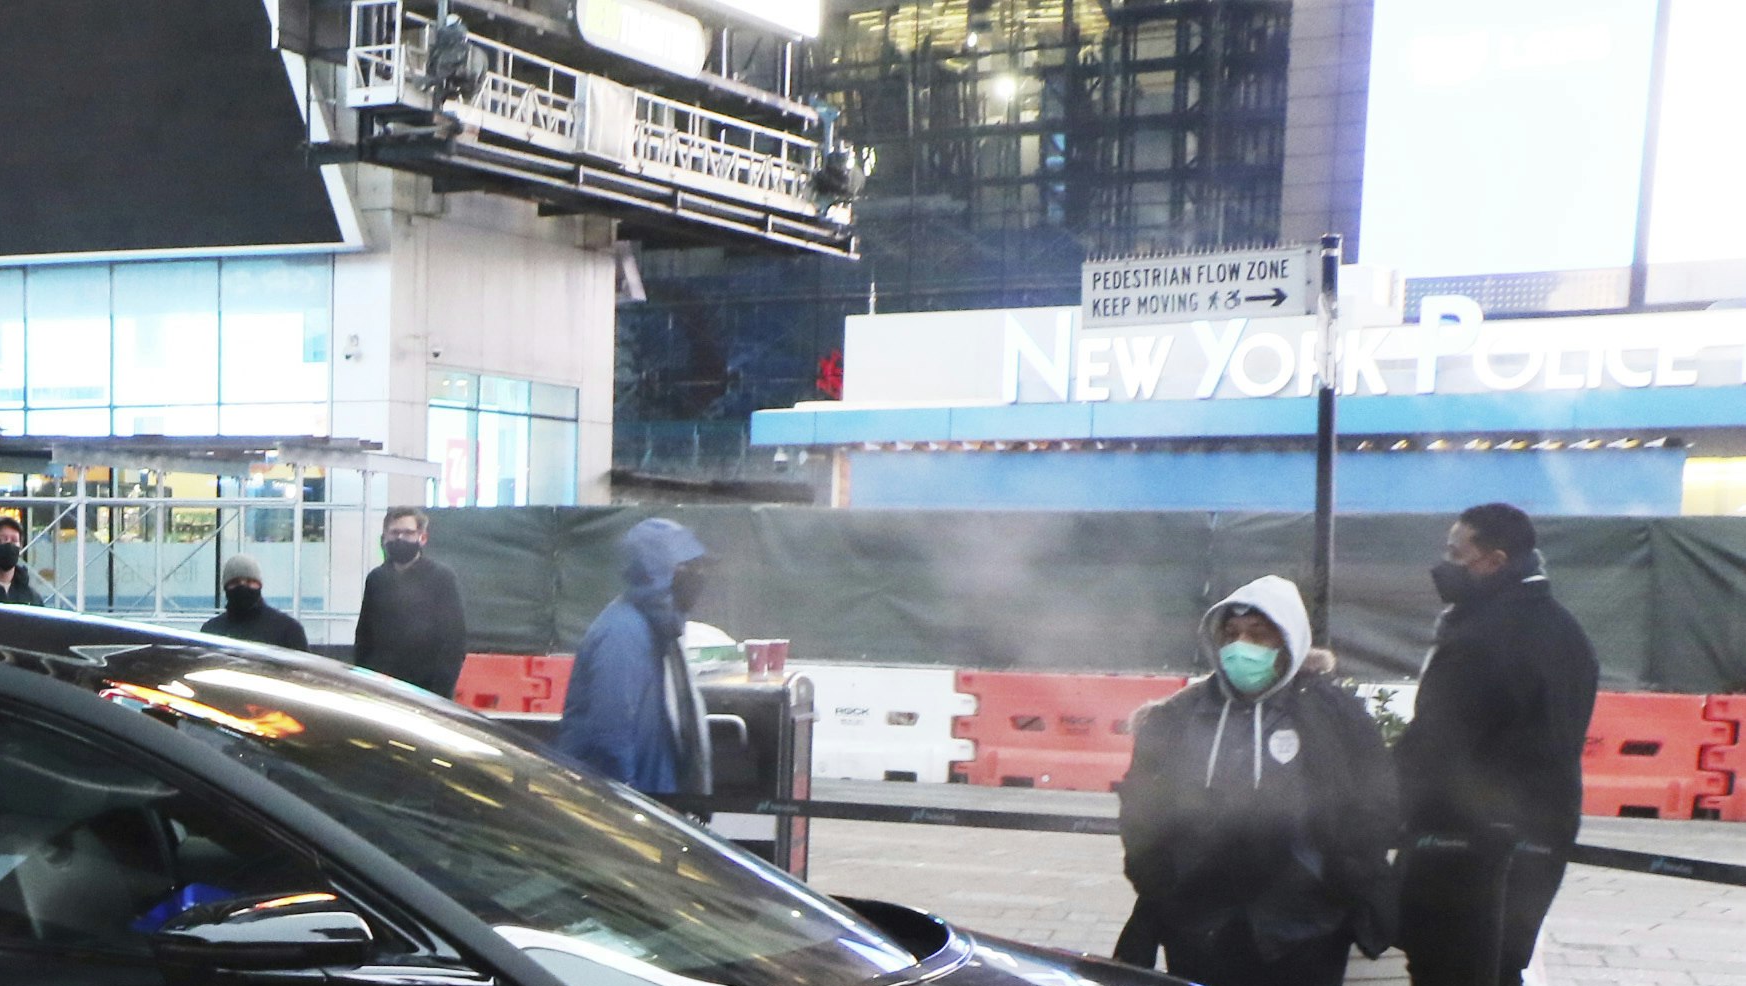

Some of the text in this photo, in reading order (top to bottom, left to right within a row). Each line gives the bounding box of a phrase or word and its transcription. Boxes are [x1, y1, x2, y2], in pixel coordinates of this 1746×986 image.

[1092, 258, 1290, 291] PEDESTRIAN FLOW ZONE
[1092, 292, 1199, 318] KEEP MOVING
[1002, 310, 1175, 405] NEW
[1415, 294, 1701, 395] POLICE
